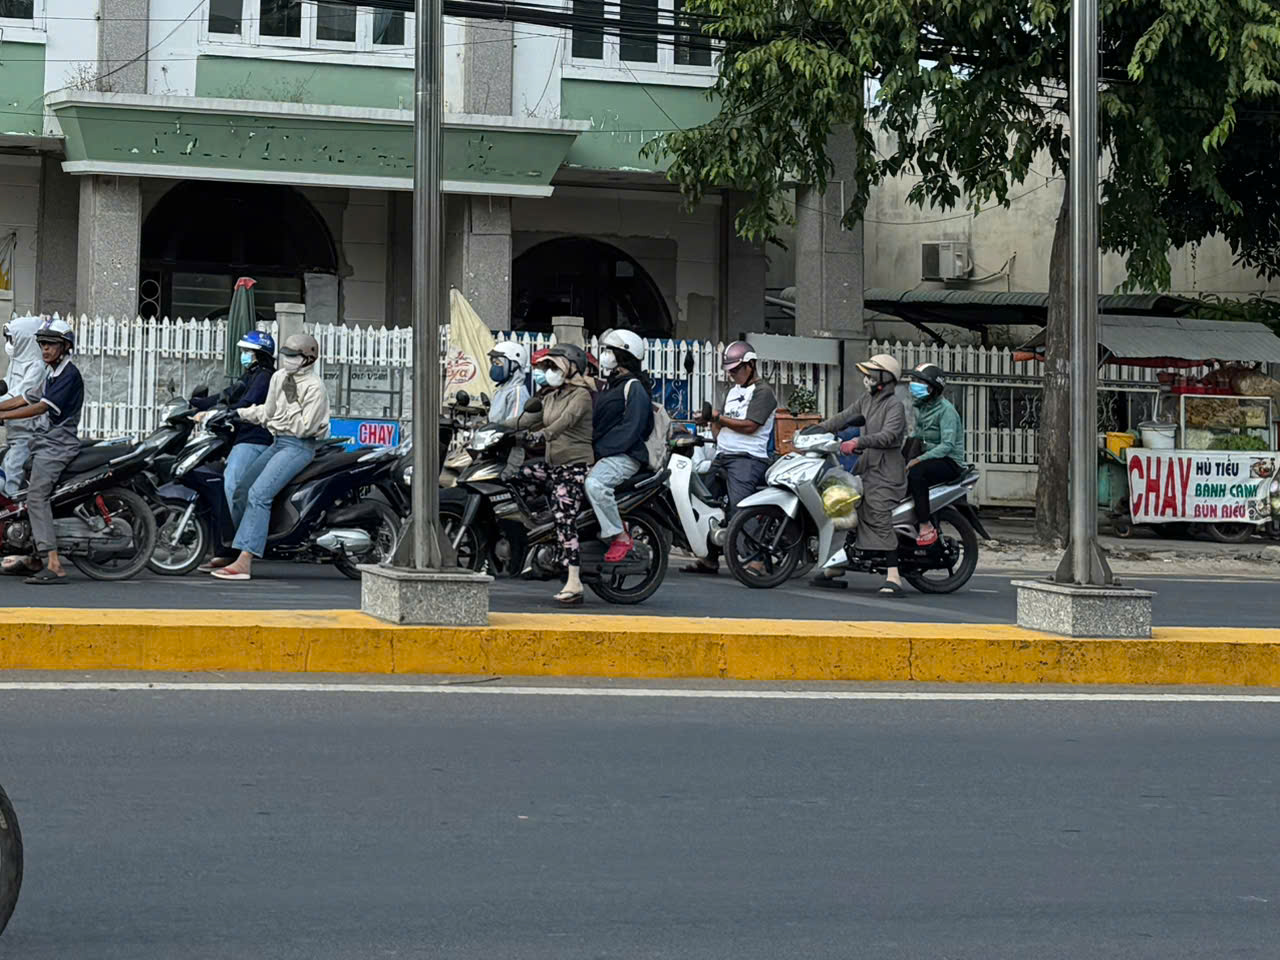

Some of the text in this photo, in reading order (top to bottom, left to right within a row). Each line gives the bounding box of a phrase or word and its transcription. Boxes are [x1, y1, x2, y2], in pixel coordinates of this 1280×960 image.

[359, 423, 394, 448] CHAY
[1129, 455, 1192, 517] CHAY
[1195, 479, 1225, 498] BÁNH
[1194, 499, 1217, 518] BÚN
